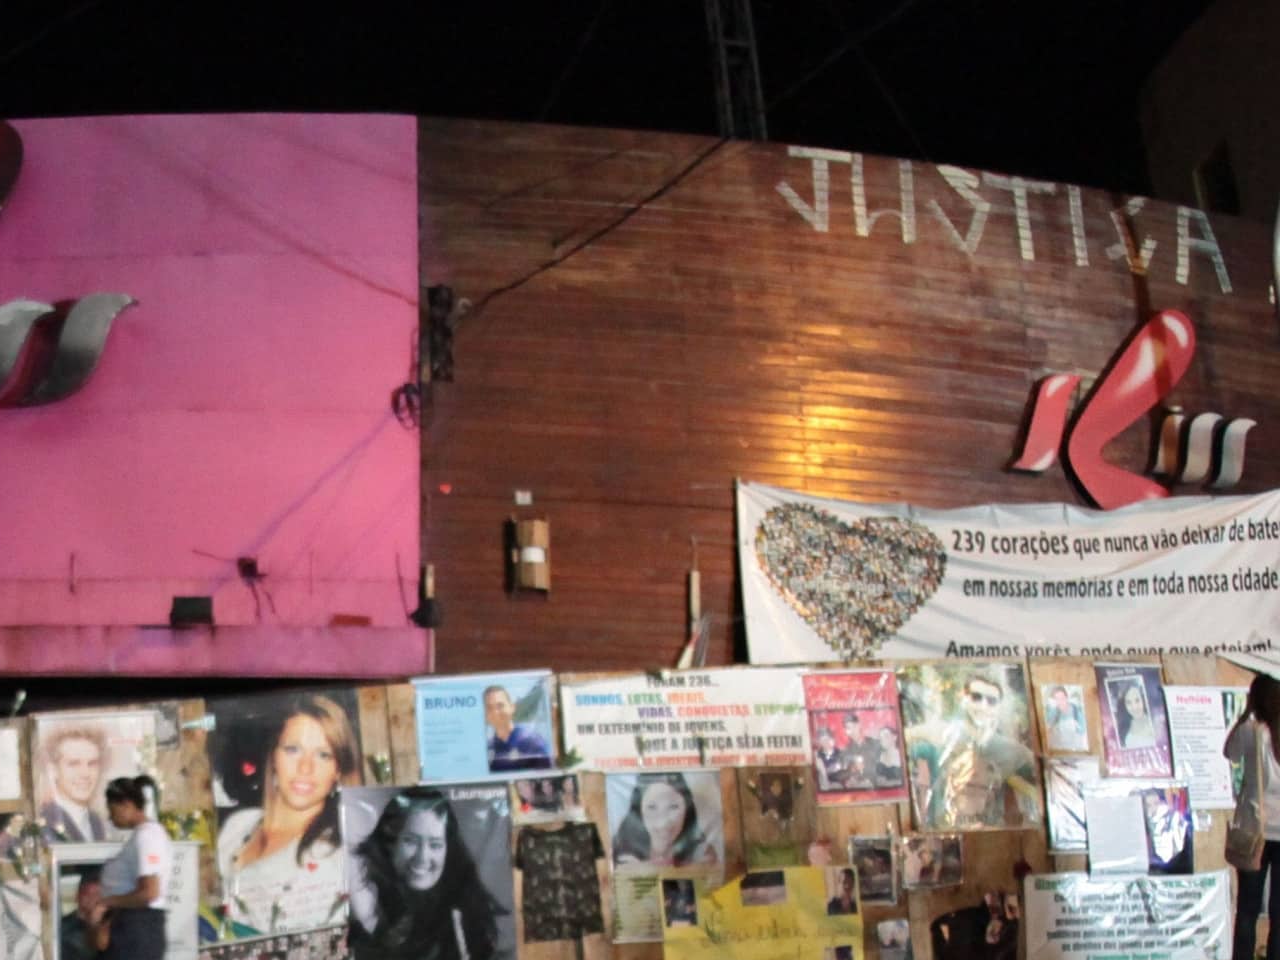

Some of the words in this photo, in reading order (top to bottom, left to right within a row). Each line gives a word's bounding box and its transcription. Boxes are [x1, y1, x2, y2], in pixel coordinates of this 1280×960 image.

[951, 529, 986, 554] 239
[991, 530, 1069, 560] corações
[1073, 537, 1101, 560] que
[1104, 533, 1149, 553] nunca
[1151, 528, 1179, 550] vão
[1181, 524, 1226, 546] deixar
[1228, 518, 1245, 542] de
[1248, 516, 1280, 540] bate
[963, 578, 986, 597] em
[989, 579, 1039, 598] nossas
[1042, 577, 1113, 598] memórias
[1116, 578, 1125, 597] e
[1128, 577, 1149, 597] em
[1152, 570, 1185, 595] toda
[1187, 573, 1228, 594] nossa
[1231, 567, 1279, 591] cidade
[945, 640, 1020, 657] Amamos
[423, 695, 478, 710] BRUNO
